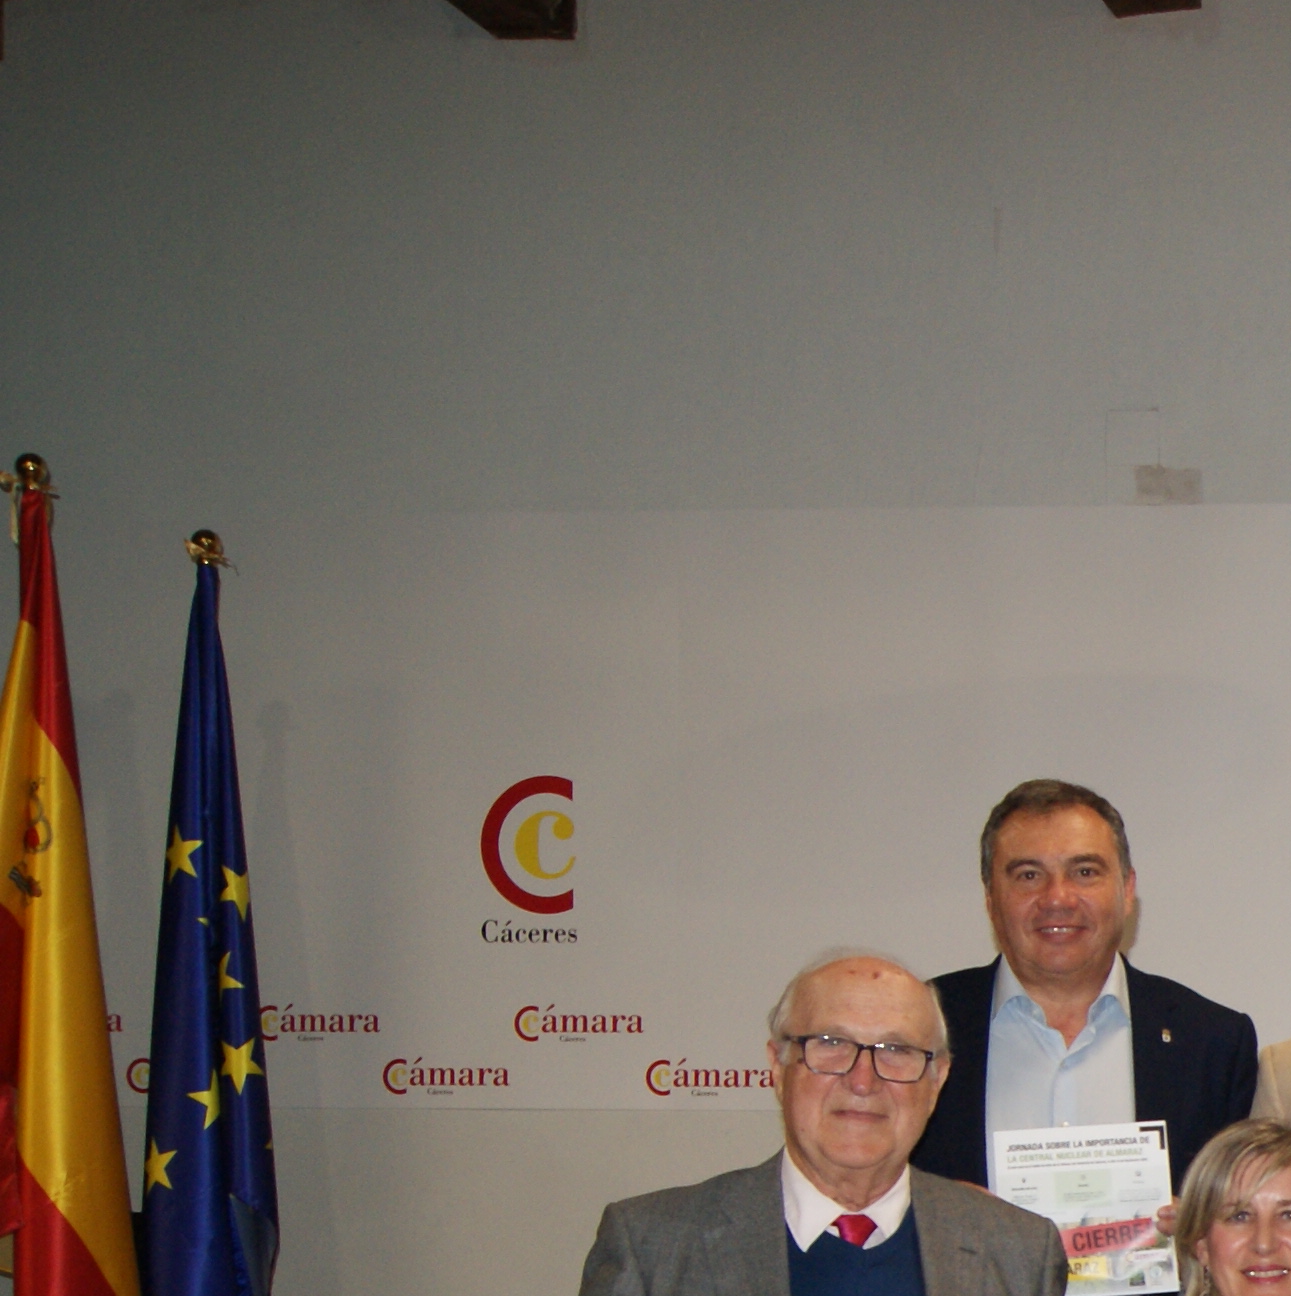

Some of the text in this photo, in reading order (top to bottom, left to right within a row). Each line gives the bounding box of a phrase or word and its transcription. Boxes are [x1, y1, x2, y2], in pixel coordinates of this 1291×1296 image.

[481, 920, 577, 943] Cáceres
[514, 1004, 643, 1041] Cámara
[383, 1057, 509, 1094] Cámara
